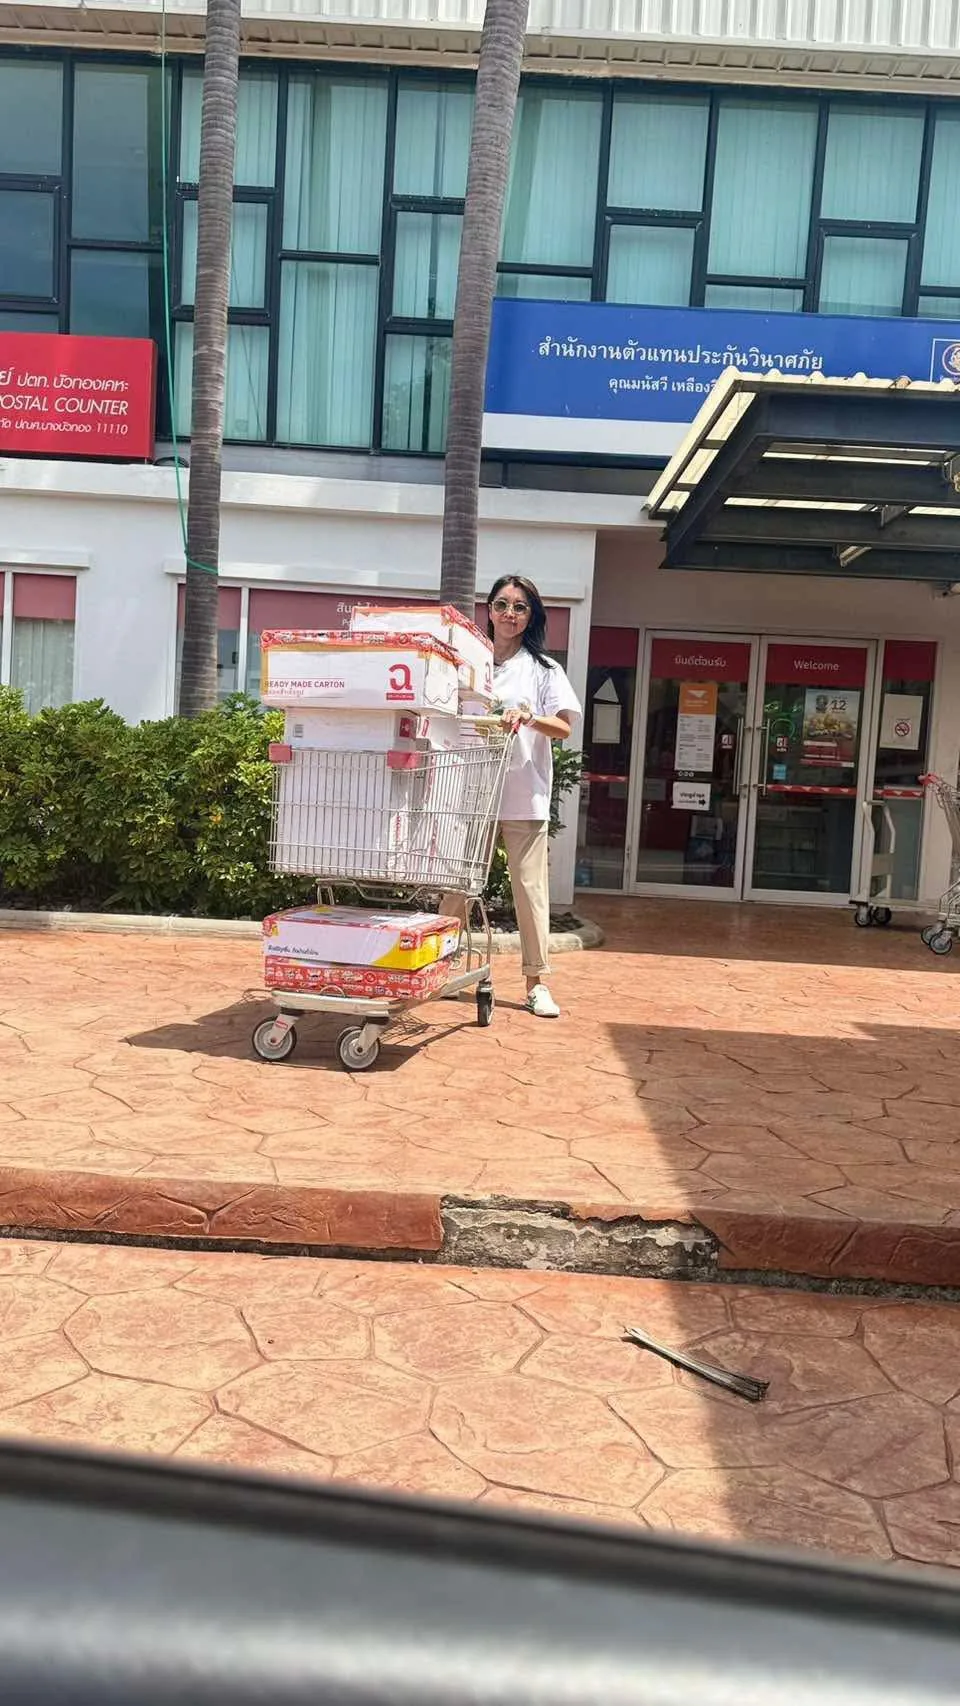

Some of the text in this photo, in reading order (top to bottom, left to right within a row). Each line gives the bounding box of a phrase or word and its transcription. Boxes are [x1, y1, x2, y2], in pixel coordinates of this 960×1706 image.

[538, 335, 823, 371] สำนักงานตัวแทนประกันวินาศภัย
[55, 397, 129, 416] COUNTER
[96, 422, 129, 435] 11110
[793, 659, 841, 671] Welcome
[290, 680, 312, 688] MADE
[314, 680, 345, 688] CARTON
